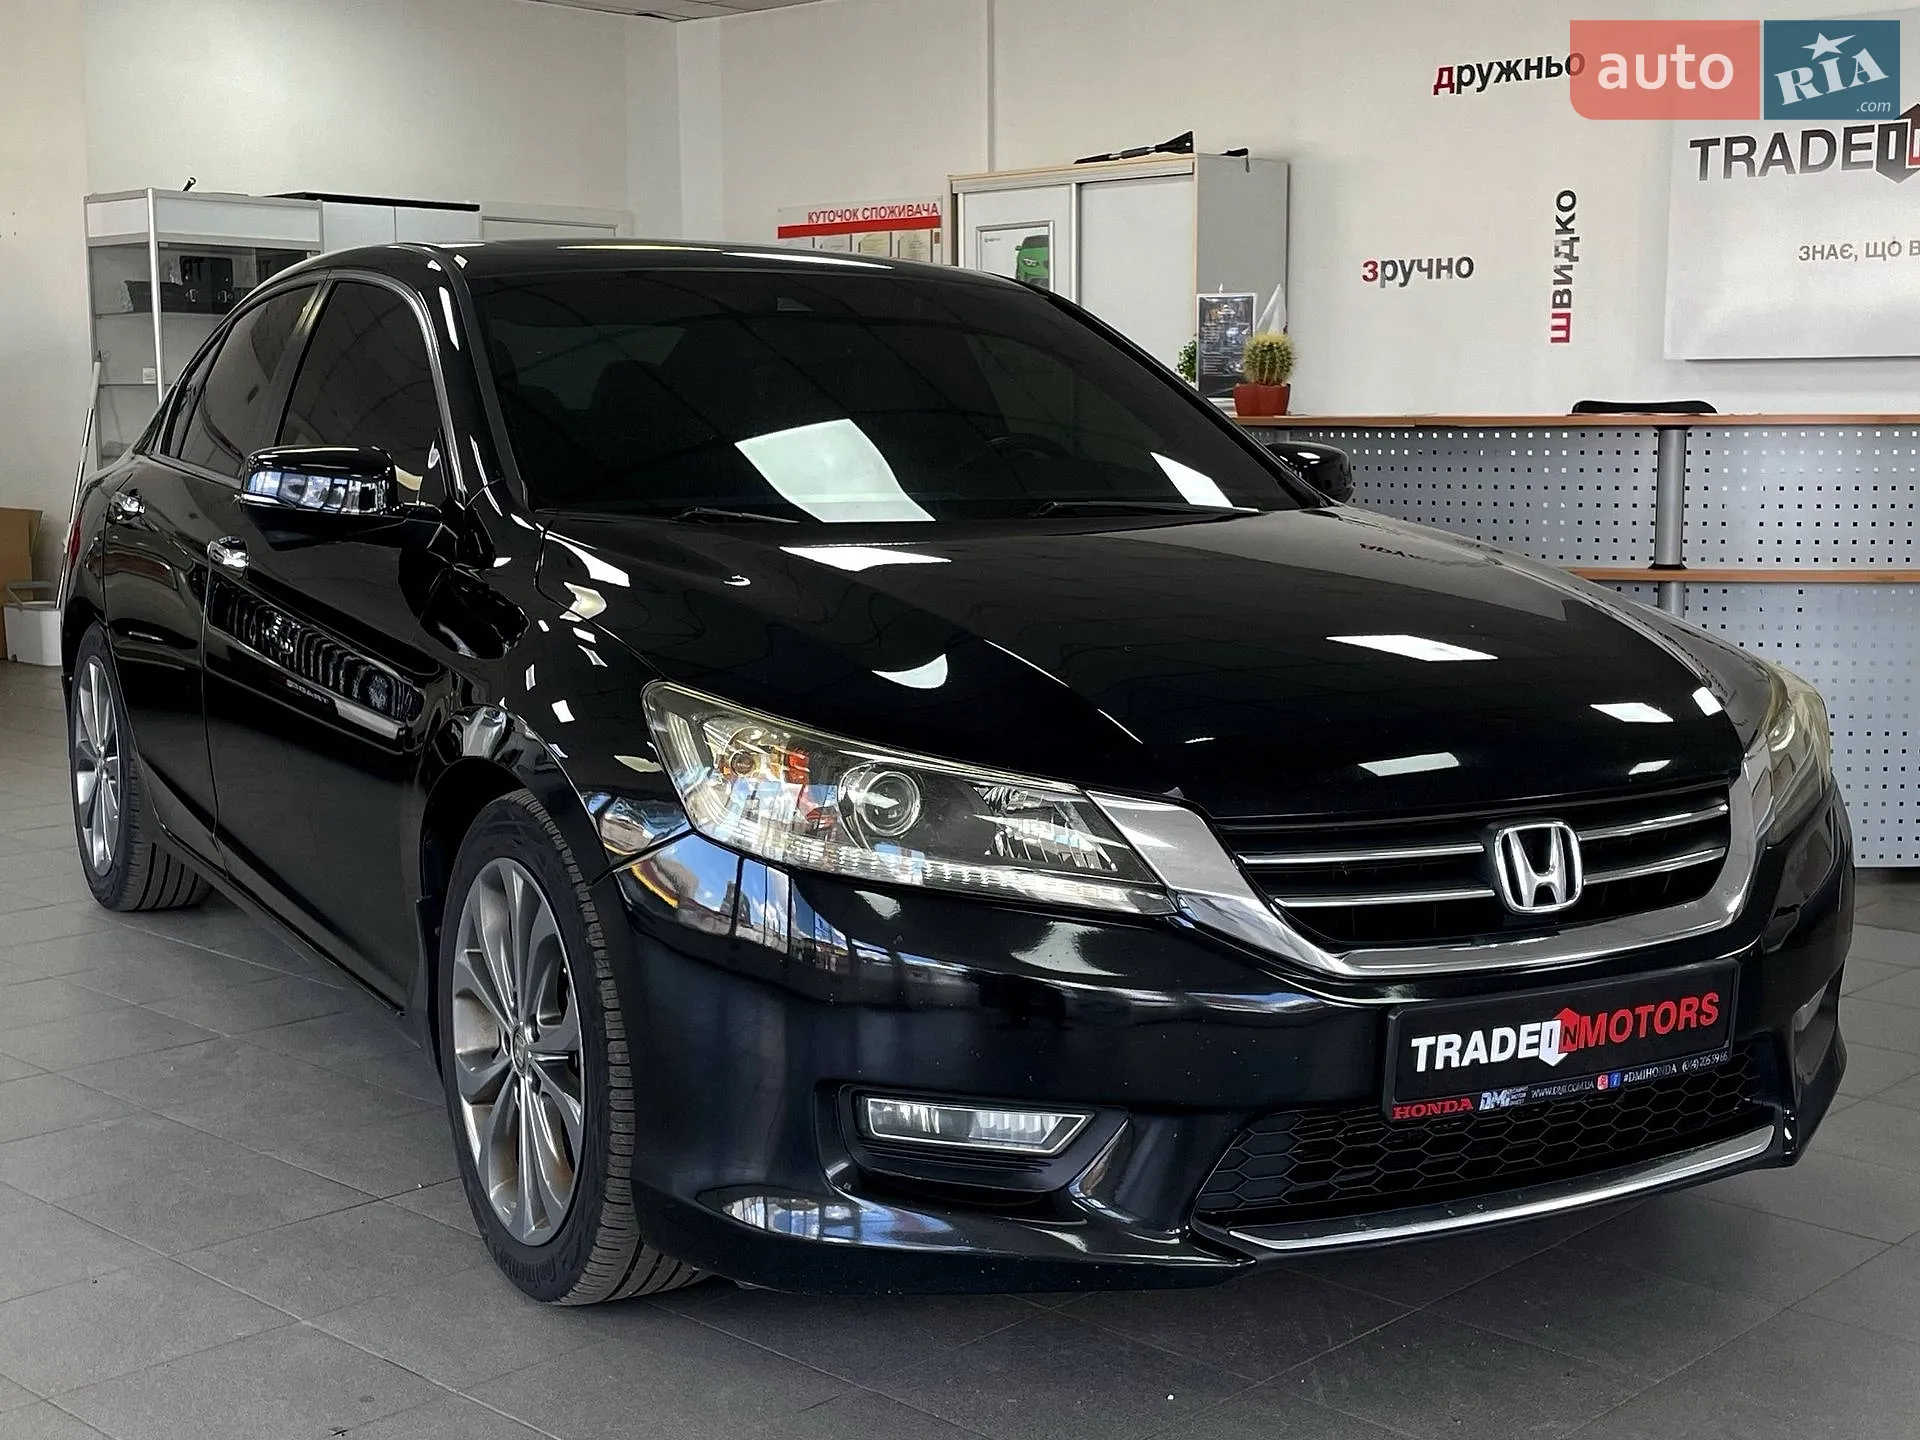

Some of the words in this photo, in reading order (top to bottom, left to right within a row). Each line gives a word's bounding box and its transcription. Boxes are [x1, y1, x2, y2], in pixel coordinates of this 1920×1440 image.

[1433, 52, 1586, 95] дружньо
[807, 208, 860, 224] КУТОЧОК
[861, 202, 939, 220] СПОЖИВАЧА
[1798, 243, 1858, 262] ЗНАЄ,
[1865, 239, 1902, 261] ЩО
[1362, 255, 1475, 288] зручно
[1550, 189, 1580, 344] швидко
[1393, 1096, 1474, 1119] HONDA
